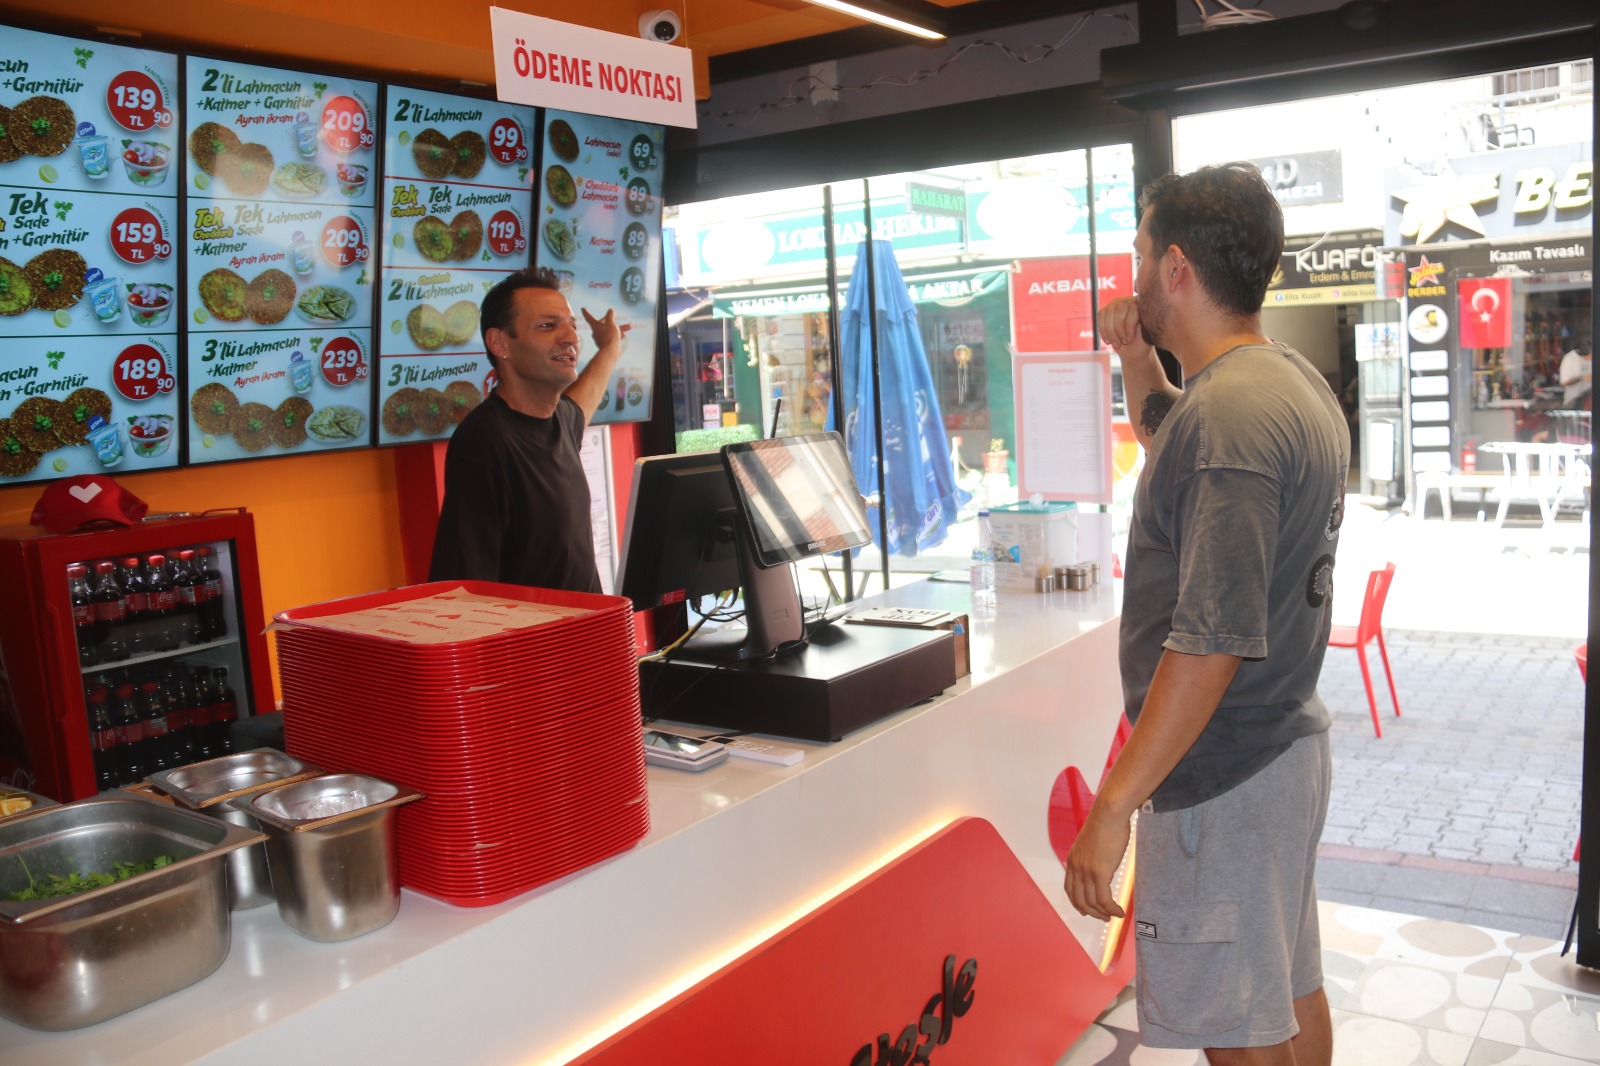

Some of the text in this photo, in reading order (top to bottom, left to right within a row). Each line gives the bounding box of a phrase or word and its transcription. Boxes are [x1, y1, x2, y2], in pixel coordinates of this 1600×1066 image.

[144, 65, 165, 87] TANITIM
[513, 37, 683, 102] ÖDEME NOKTASI
[235, 79, 302, 95] Lahmacun
[114, 85, 157, 110] 139
[264, 96, 315, 110] Garnitür
[129, 115, 144, 127] TL
[235, 114, 265, 127] Ayran
[267, 113, 293, 124] ikram
[323, 109, 365, 132] 209
[423, 108, 483, 123] Lahmacun
[339, 137, 351, 147] TL
[493, 125, 519, 148] 99
[585, 136, 622, 150] Lahmacun
[501, 151, 511, 160] TL
[633, 142, 650, 158] 69
[1273, 158, 1298, 182] D
[392, 184, 511, 207] Tek Tek Lahmacun
[582, 190, 618, 202] Lahmacun
[629, 185, 647, 202] 89
[911, 188, 965, 211] BAHARAT
[9, 192, 49, 215] Tek
[144, 201, 164, 222] TANITIM
[430, 203, 452, 214] Sade
[13, 215, 49, 229] Sade
[195, 203, 322, 229] Tek Tek Lahmacun
[116, 222, 157, 244] 159
[236, 224, 264, 236] Sade
[491, 221, 515, 239] 119
[628, 230, 645, 246] 89
[325, 229, 360, 248] 209
[589, 236, 615, 247] Katmer
[131, 249, 145, 259] TL
[500, 243, 508, 252] TL
[632, 249, 639, 257] TL
[229, 253, 285, 269] Ayran ikram
[336, 253, 348, 263] TL
[625, 275, 642, 292] 19
[1310, 270, 1340, 283] Erdem
[1341, 269, 1350, 281] &
[416, 282, 474, 300] Lahmacun
[921, 278, 983, 299] AKTAR
[237, 337, 301, 357] Lahmacun
[323, 349, 358, 369] 239
[120, 358, 161, 380] 189
[421, 361, 477, 382] Lahmacun
[233, 375, 260, 389] Ayran
[261, 370, 285, 382] ikram
[336, 373, 348, 382] TL
[134, 386, 148, 396] TL
